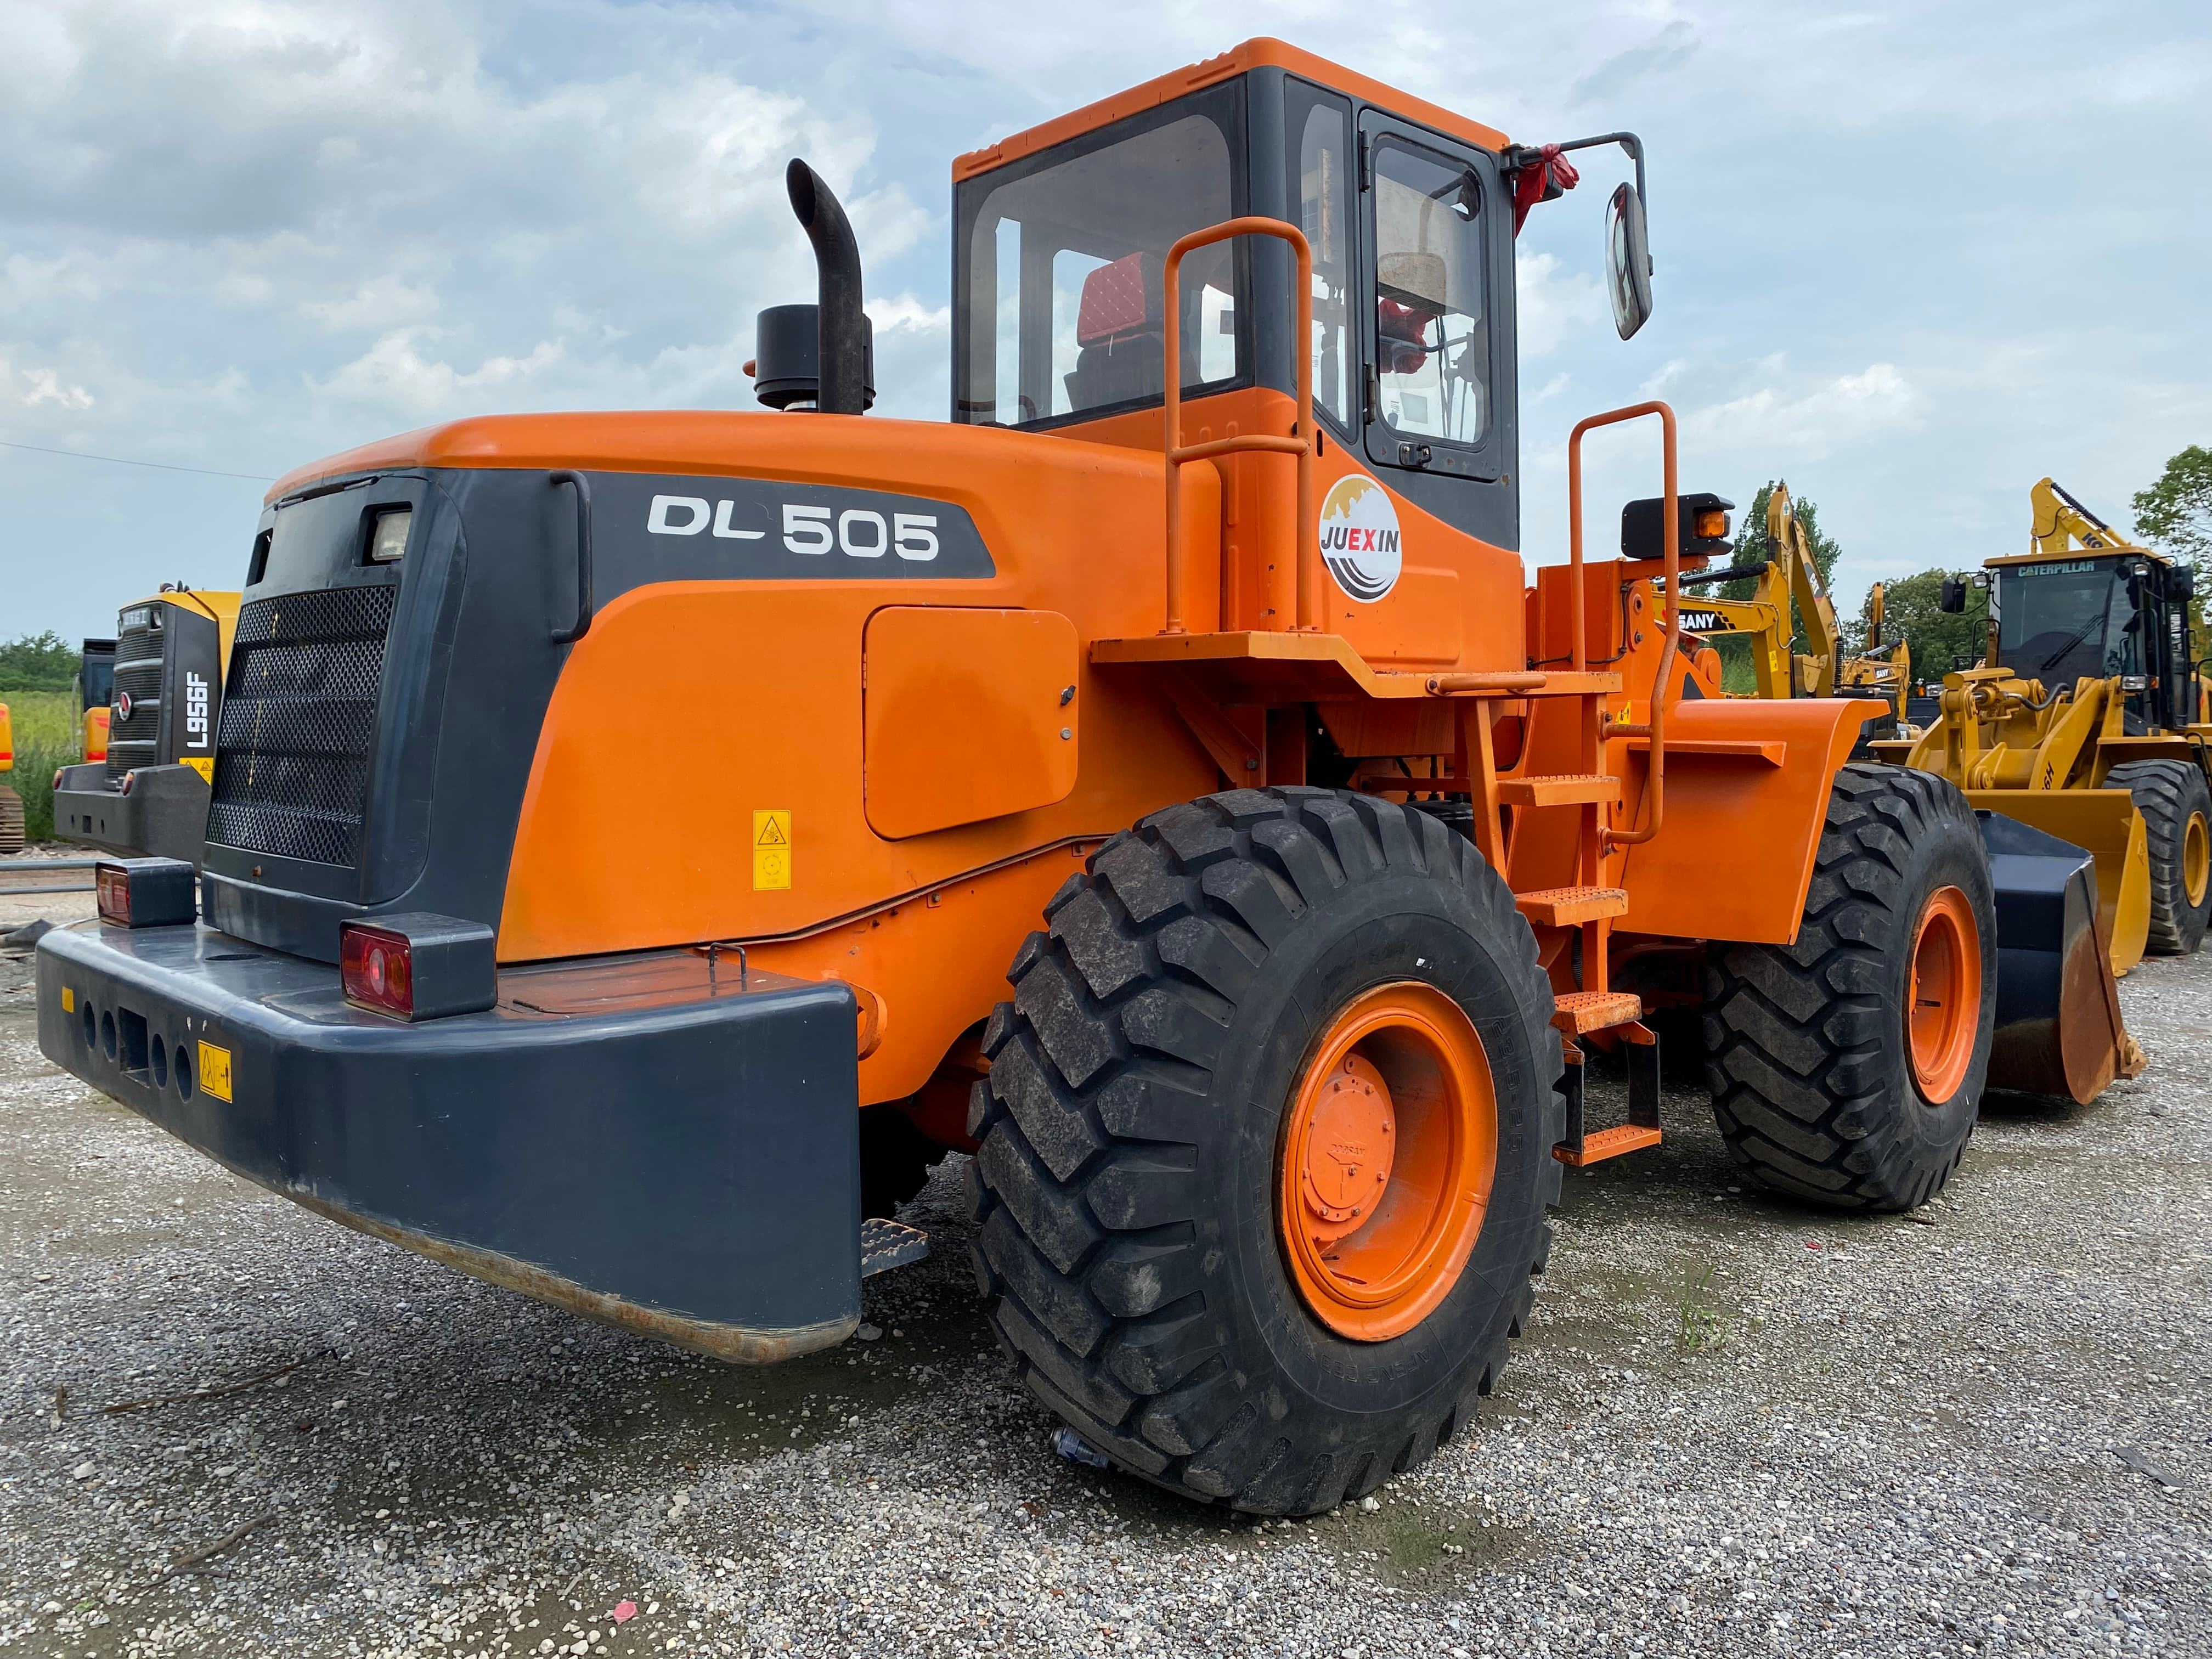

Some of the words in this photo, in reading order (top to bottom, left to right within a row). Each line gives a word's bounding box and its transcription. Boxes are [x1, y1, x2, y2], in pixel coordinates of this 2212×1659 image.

[647, 495, 765, 539] DL
[782, 504, 939, 561] 505
[1321, 527, 1399, 552] JUEXIN
[2018, 561, 2095, 577] CATERPILLAR
[1679, 613, 1716, 629] SANY
[187, 671, 208, 748] L956F
